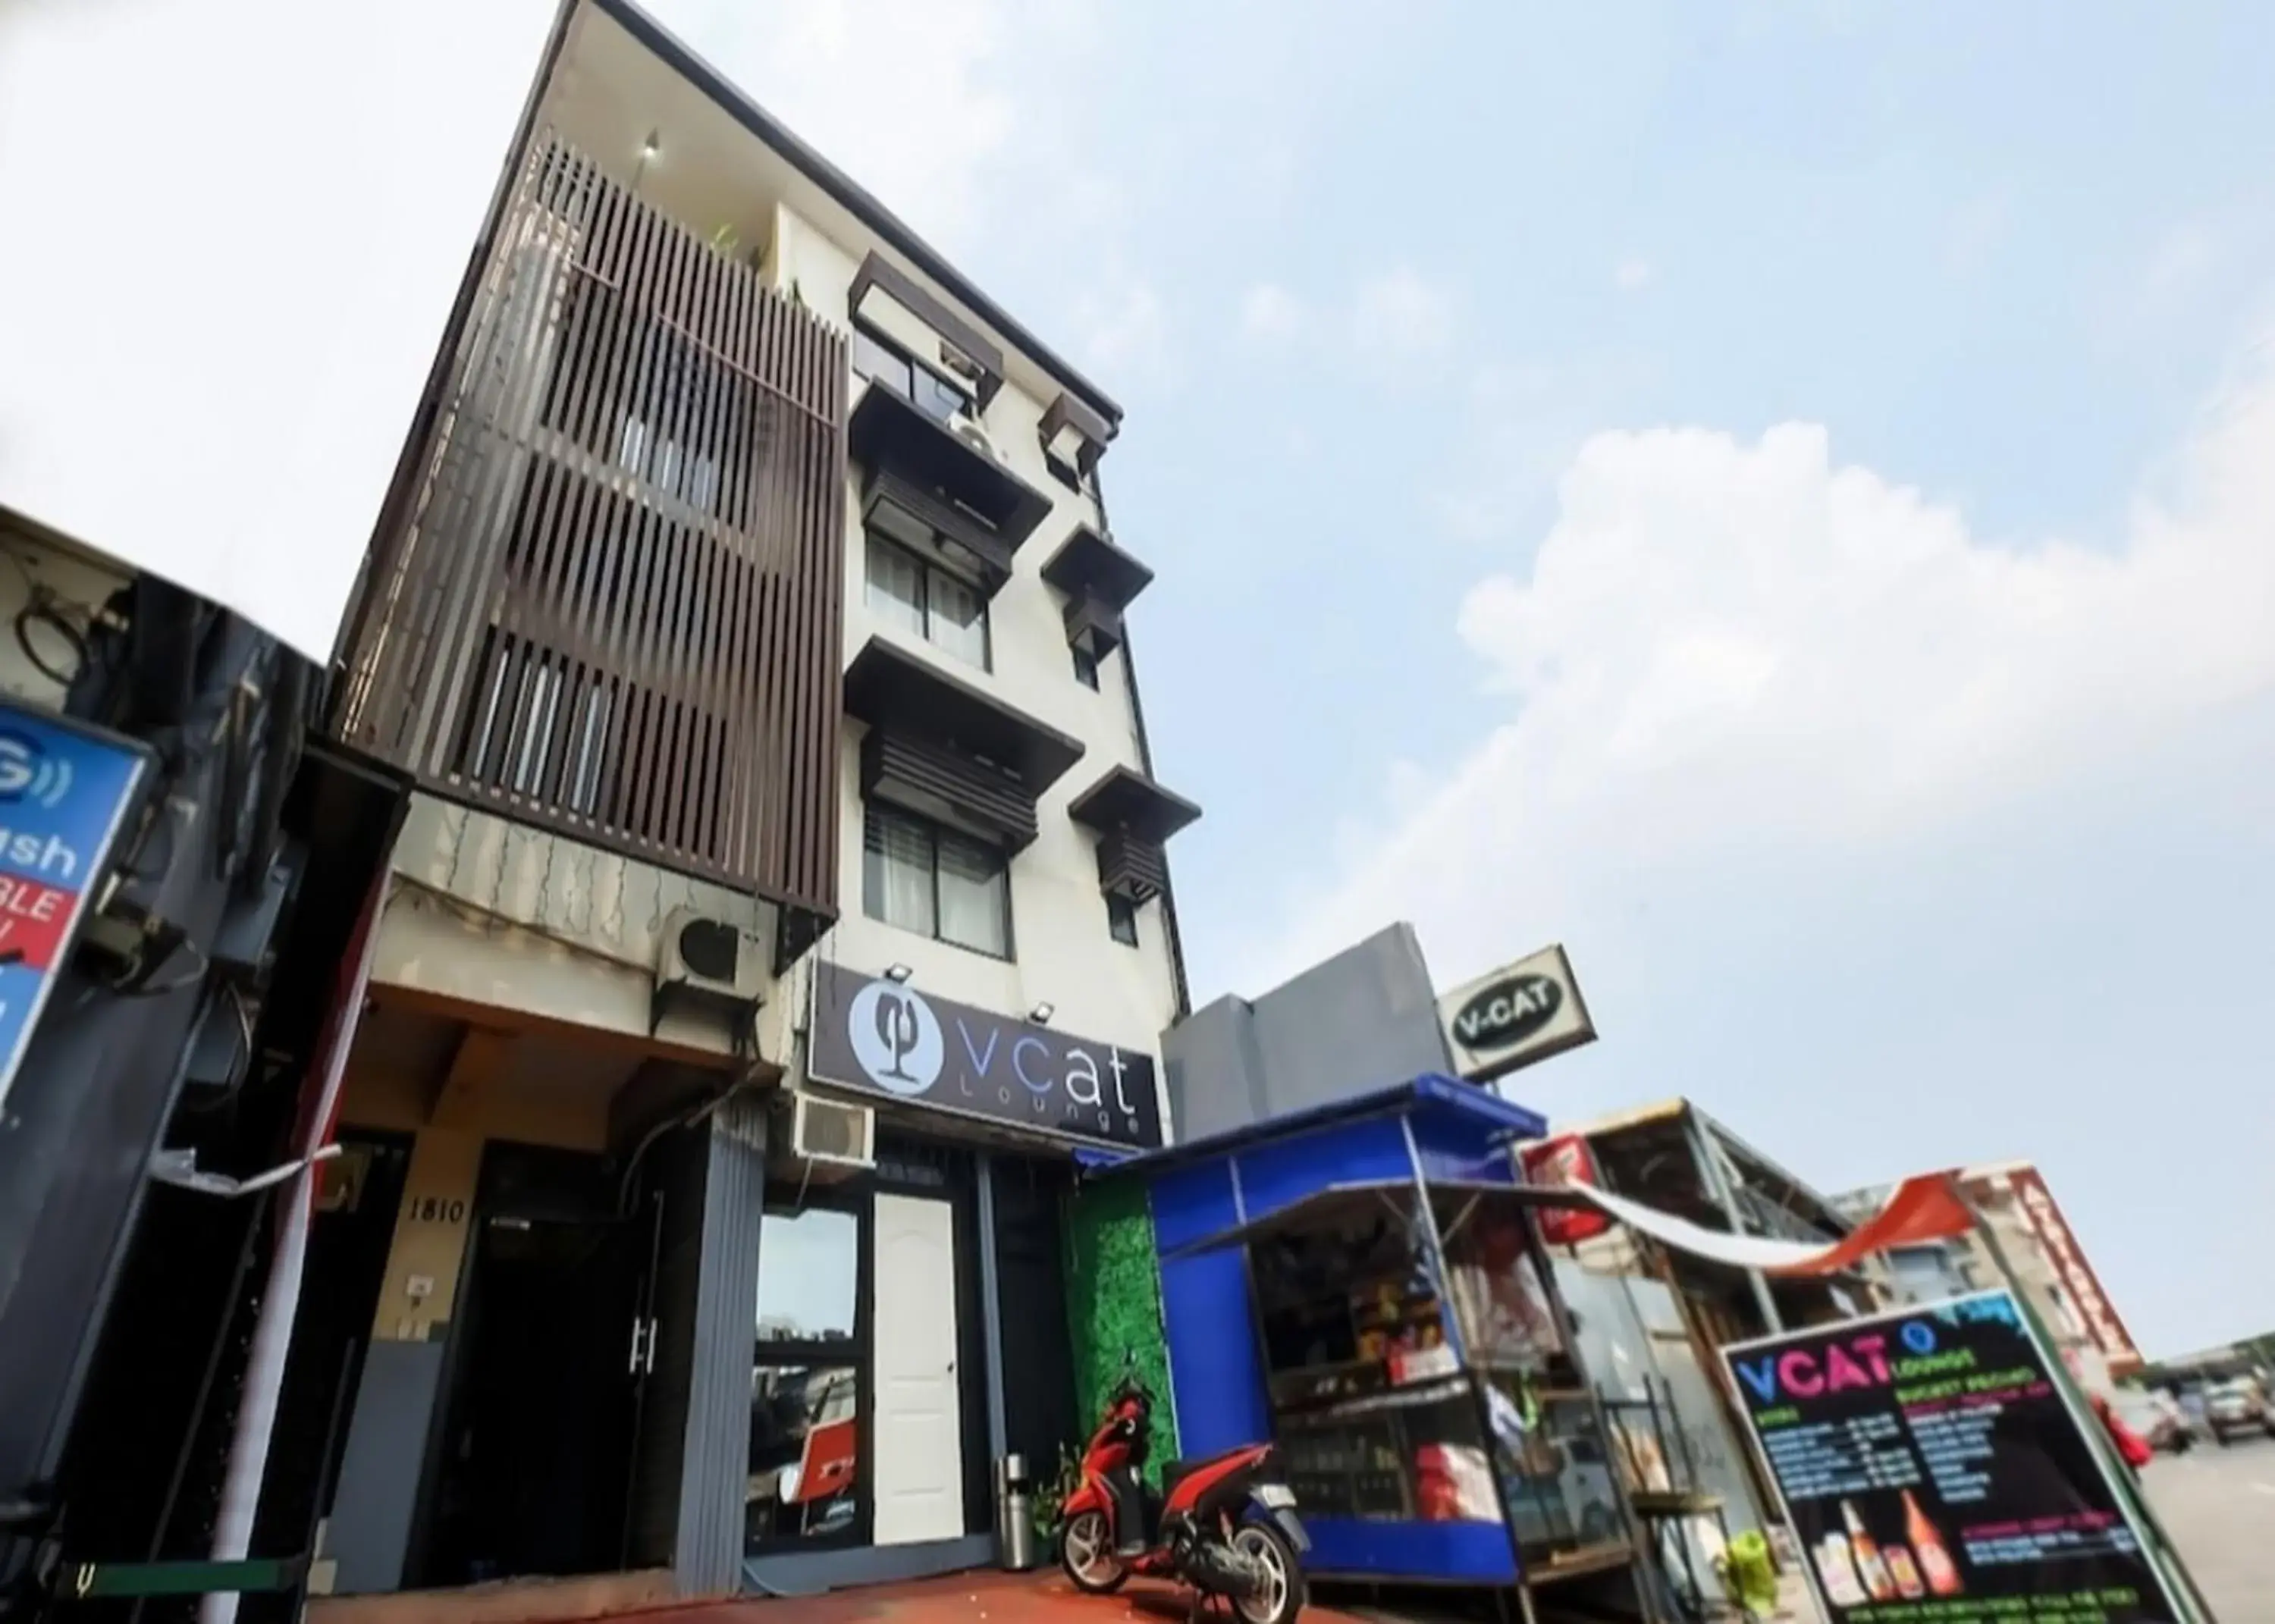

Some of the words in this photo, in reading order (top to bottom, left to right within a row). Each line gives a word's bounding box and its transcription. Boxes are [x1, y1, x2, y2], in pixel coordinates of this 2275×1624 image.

[1458, 980, 1549, 1038] V-CAT
[410, 1196, 465, 1224] 1810
[1737, 1335, 1890, 1403] VCAT
